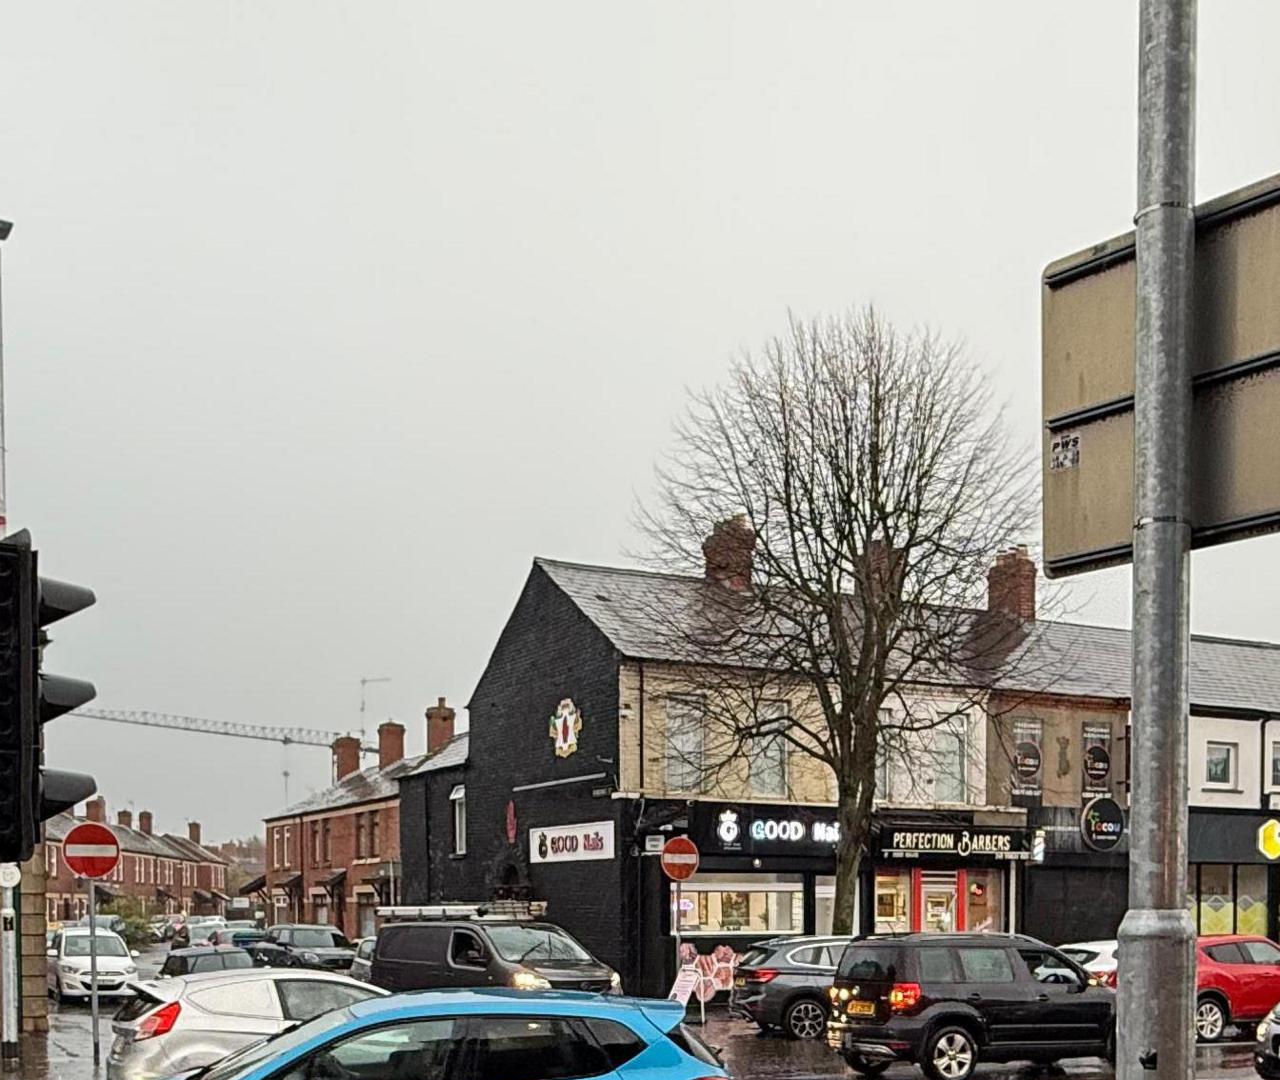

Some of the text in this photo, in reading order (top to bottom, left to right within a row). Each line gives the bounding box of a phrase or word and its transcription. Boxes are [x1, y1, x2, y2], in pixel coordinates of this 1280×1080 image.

[751, 820, 805, 841] GOOD
[550, 834, 579, 854] GOOD
[893, 830, 1011, 857] PERFECTION BARBERS
